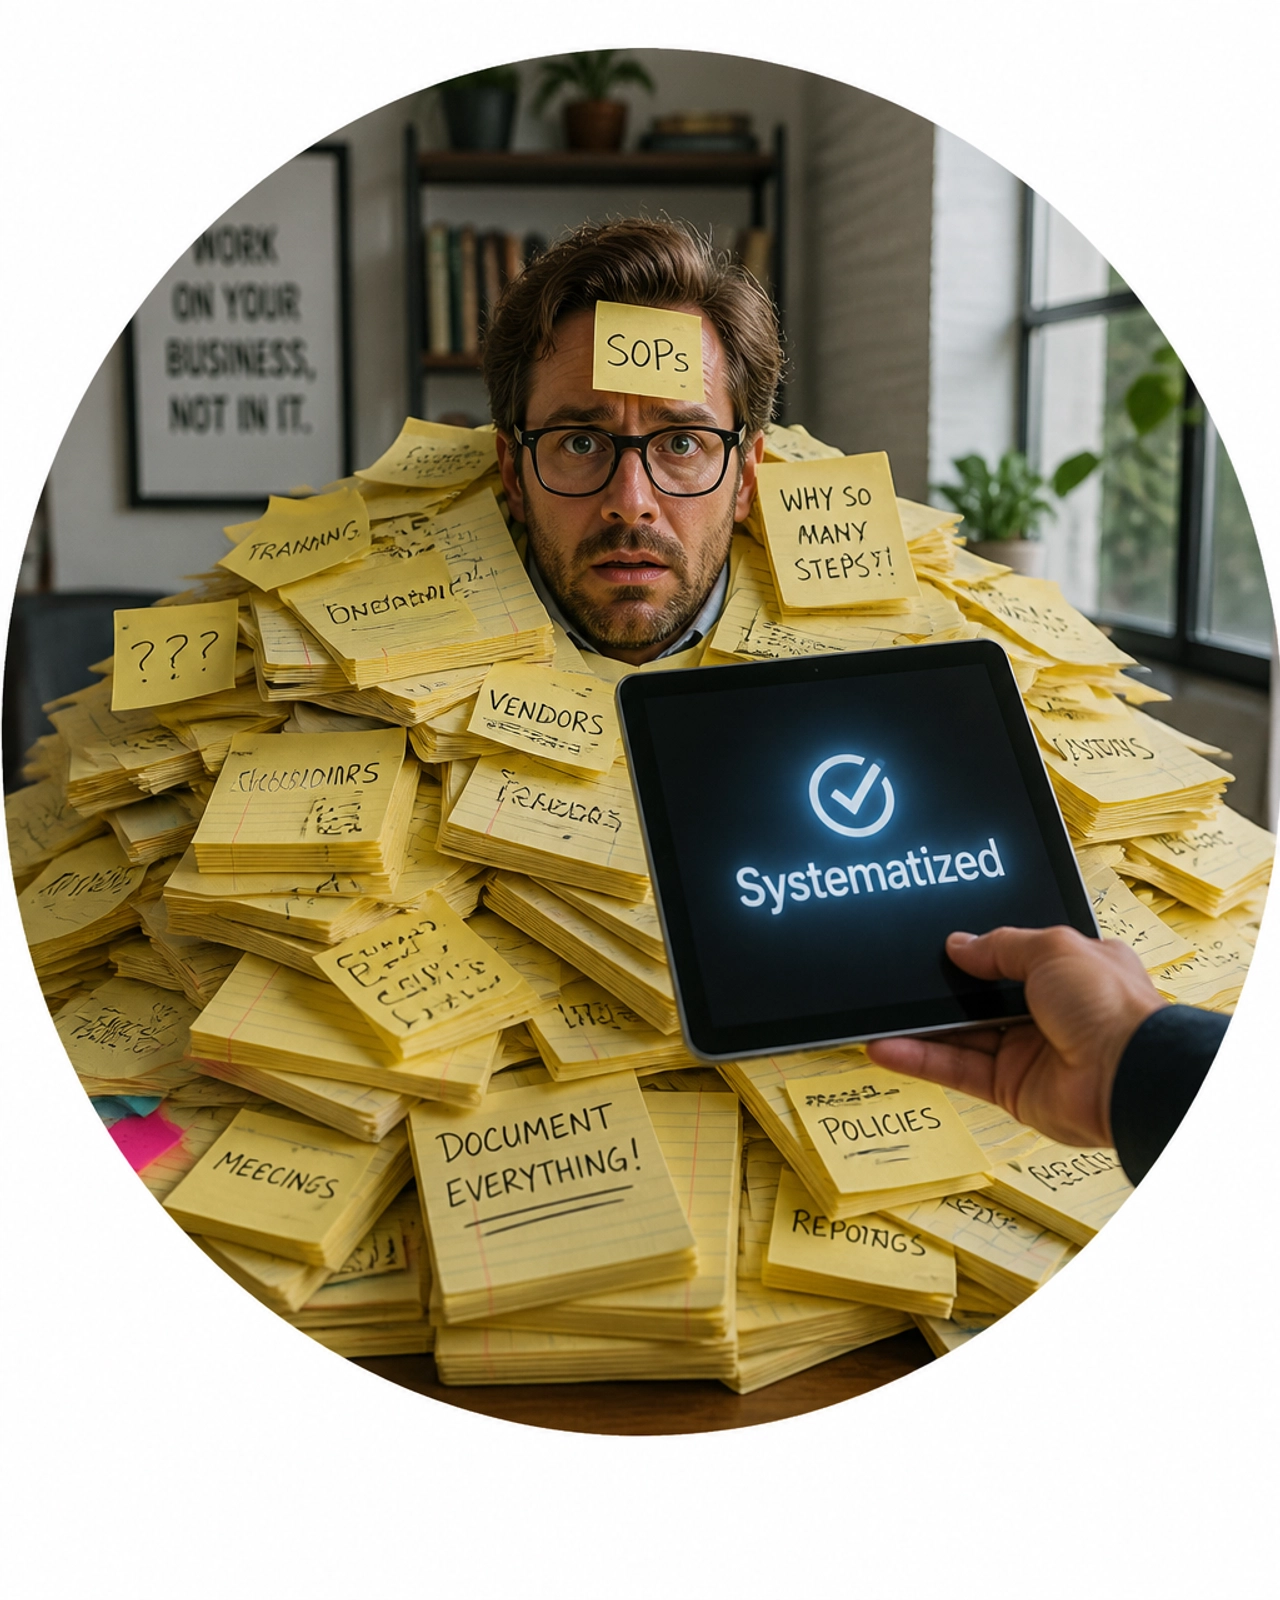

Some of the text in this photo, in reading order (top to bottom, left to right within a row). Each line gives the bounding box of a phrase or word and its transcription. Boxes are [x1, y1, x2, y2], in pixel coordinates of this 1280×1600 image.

[193, 225, 279, 266] WORK
[172, 281, 301, 323] ON YOUR
[165, 337, 316, 382] BUSINESS,
[607, 334, 689, 372] SOPs
[168, 393, 313, 434] NOT IN IT.
[780, 486, 871, 512] WHY SO
[799, 521, 867, 545] MANY
[490, 689, 603, 735] VENDORS
[736, 837, 1006, 915] Systematized
[435, 1102, 613, 1163] DOCUMENT
[818, 1107, 941, 1145] POLICIES
[446, 1137, 641, 1208] EVERYTHING!
